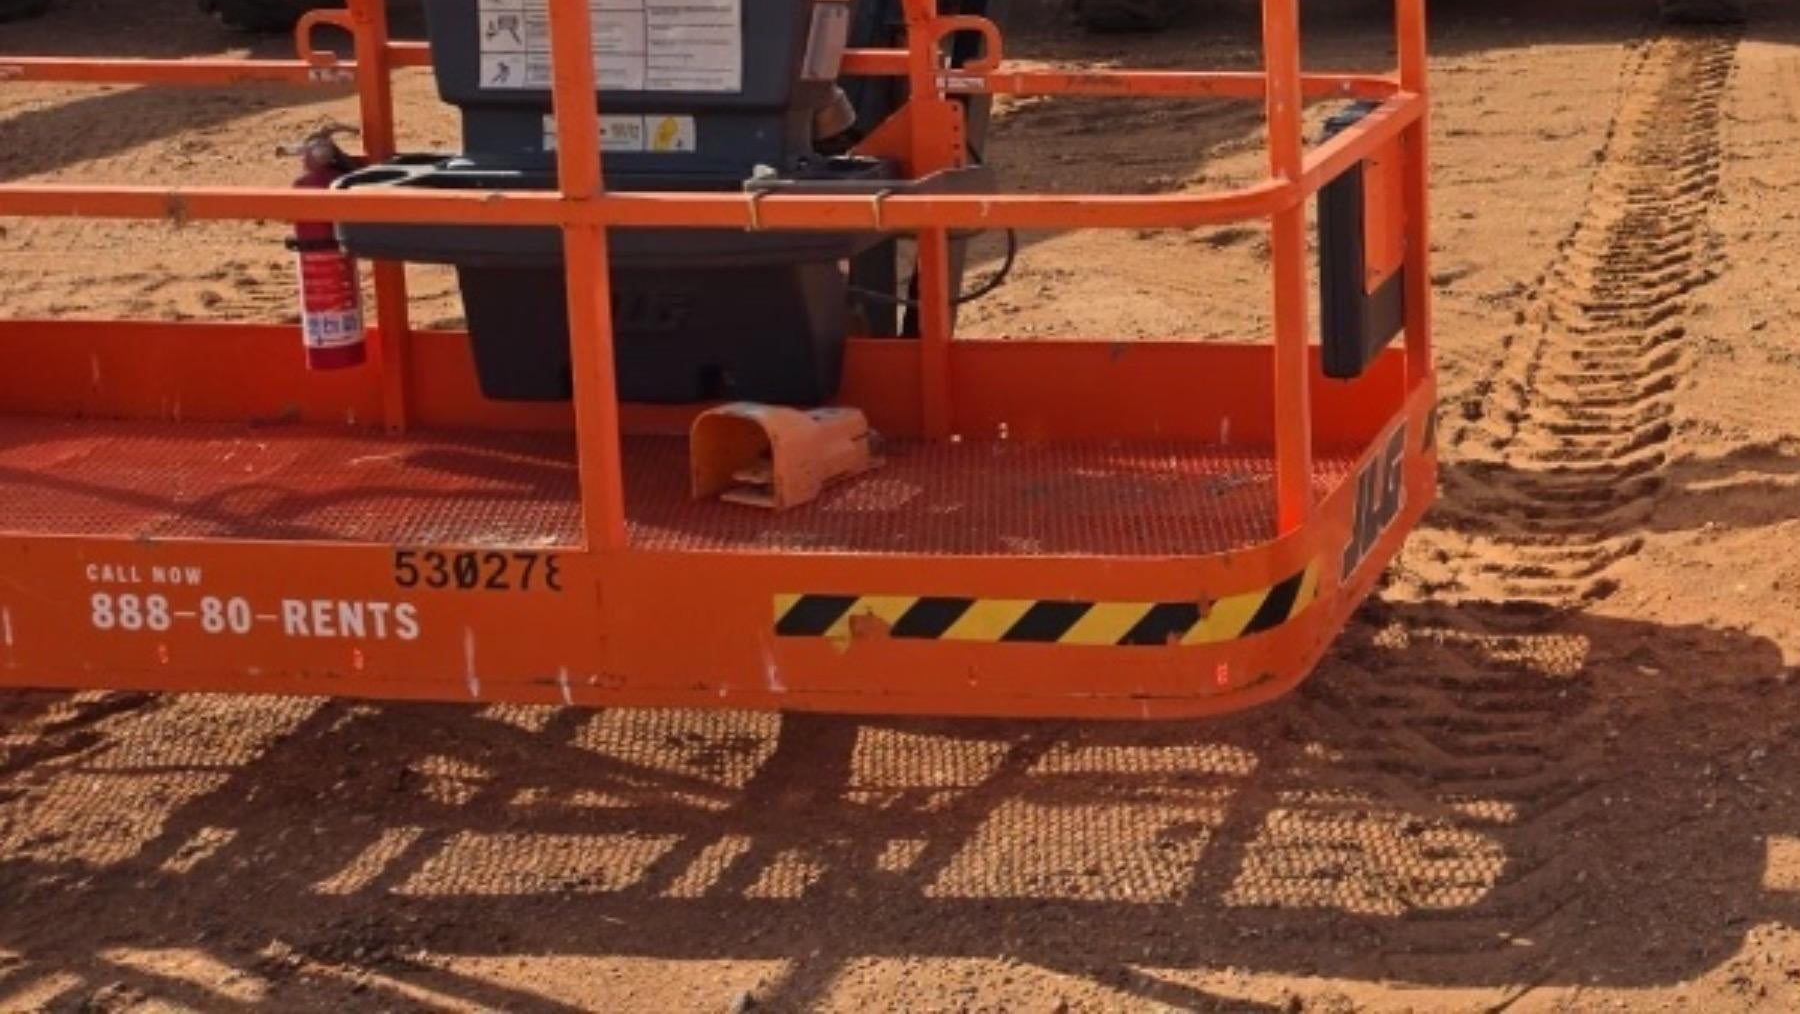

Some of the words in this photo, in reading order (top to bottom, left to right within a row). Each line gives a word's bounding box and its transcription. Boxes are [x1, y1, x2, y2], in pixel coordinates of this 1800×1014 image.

[1342, 420, 1406, 584] JLG
[86, 563, 142, 584] CALL
[152, 565, 202, 585] NOW
[90, 593, 420, 641] 888-80-RENTS
